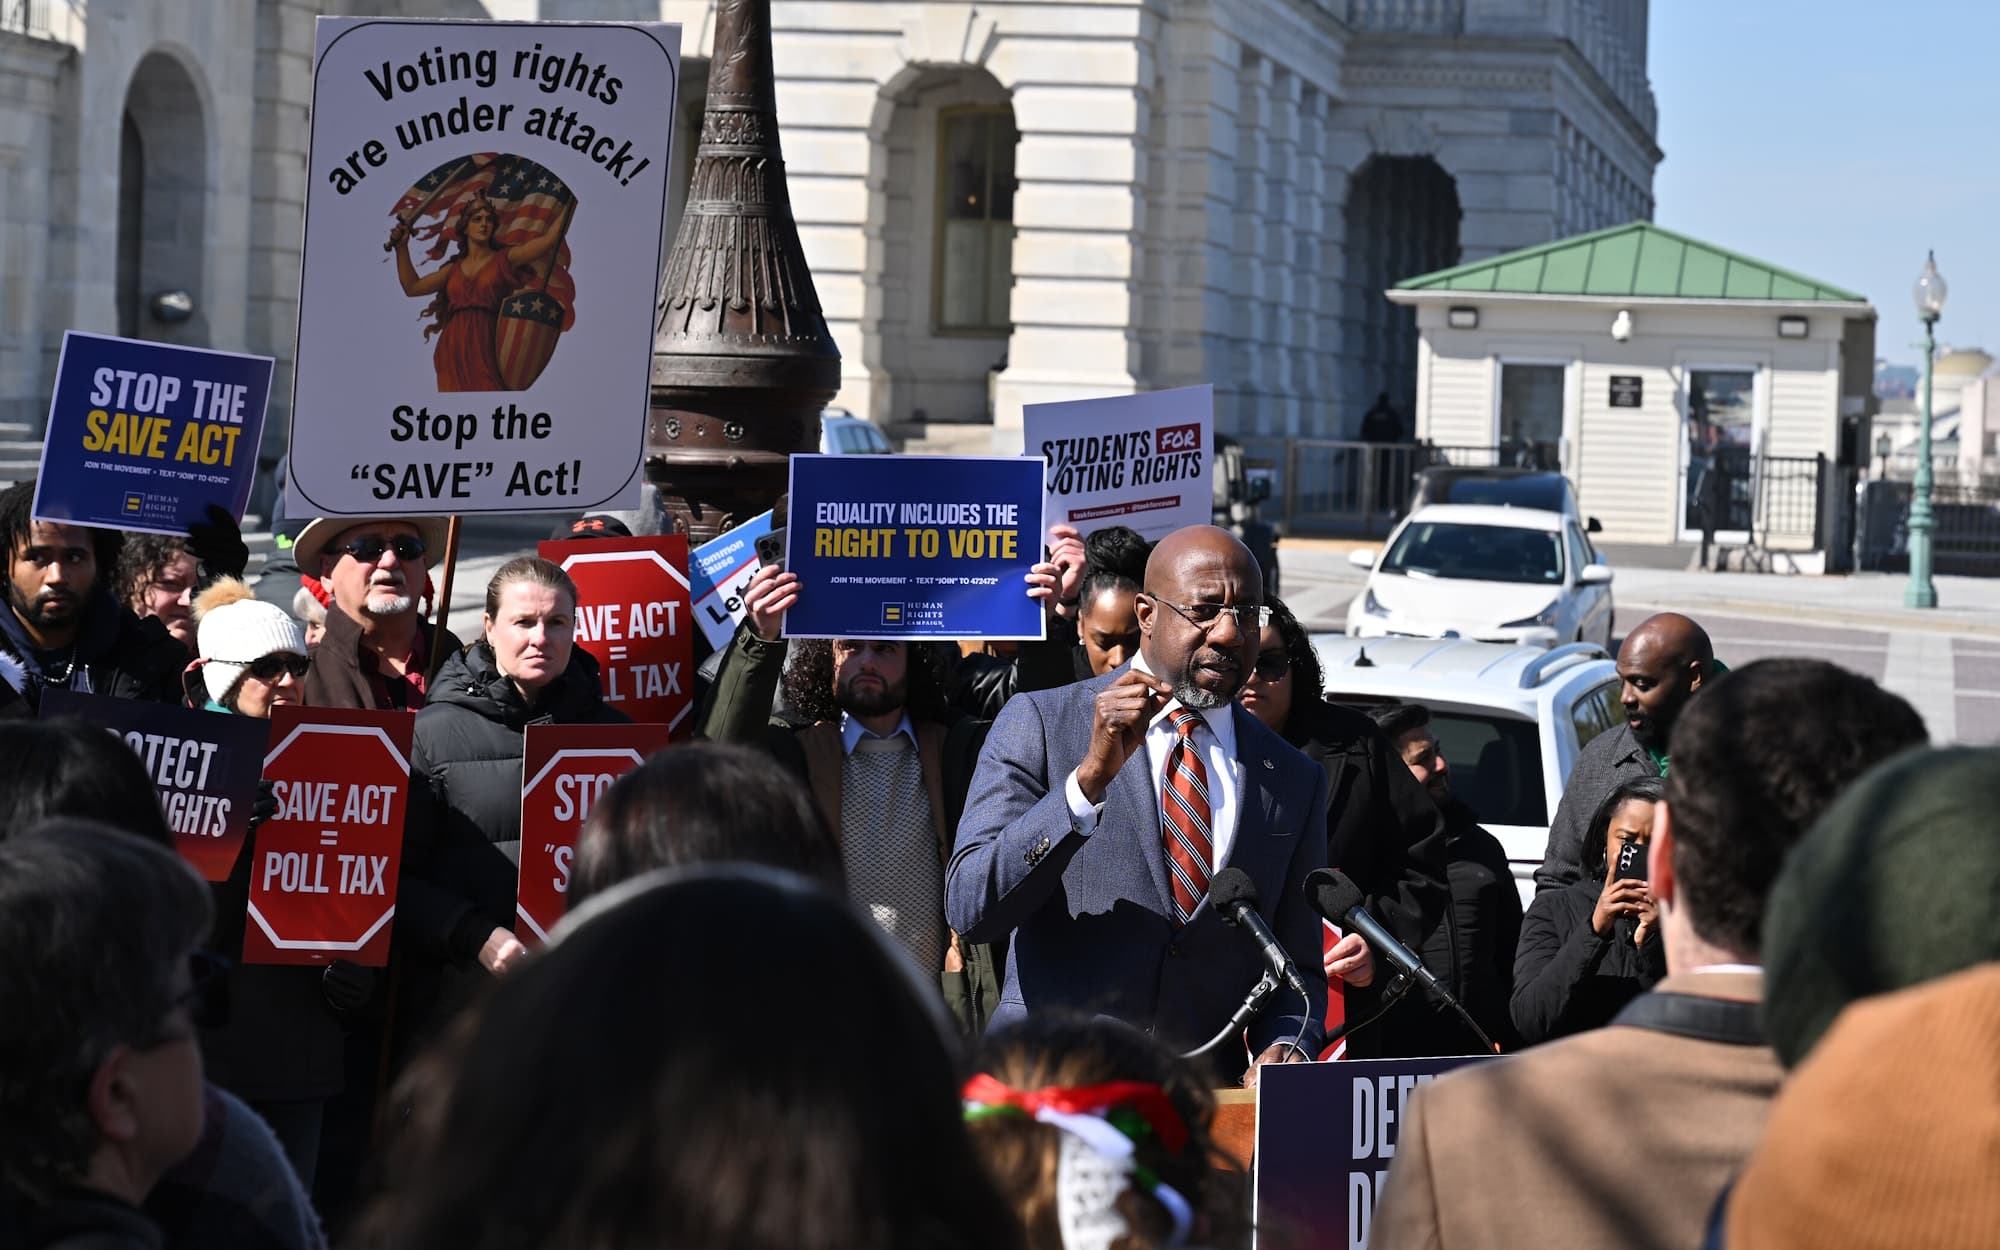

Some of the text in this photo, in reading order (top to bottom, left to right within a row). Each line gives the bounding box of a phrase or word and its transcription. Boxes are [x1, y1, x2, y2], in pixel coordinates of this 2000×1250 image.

[364, 43, 623, 105] Voting rights
[328, 96, 650, 195] are under attack!
[90, 367, 248, 424] STOP THE
[82, 409, 241, 467] SAVE ACT
[390, 404, 552, 450] Stop the
[1041, 429, 1196, 468] STUDENTS FOR
[84, 460, 100, 469] JOIN
[100, 462, 113, 471] THE
[114, 463, 152, 475] MOVEMENT
[159, 469, 176, 478] TEXT
[198, 474, 207, 482] TO
[505, 460, 581, 498] Act!
[1131, 450, 1202, 487] RIGHTS
[145, 503, 177, 513] RIGHTS
[147, 493, 179, 504] HUMAN
[815, 502, 1018, 526] EQUALITY INCLUDES THE
[695, 540, 745, 568] Common
[814, 528, 1018, 559] RIGHT TO VOTE
[700, 555, 735, 577] Cause
[830, 576, 848, 584] JOIN
[849, 576, 864, 584] THE
[865, 577, 907, 585] MOVEMENT
[916, 577, 934, 585] TEXT
[959, 577, 970, 585] TO
[572, 600, 680, 641] AVE ACT
[630, 661, 681, 699] TAX
[155, 790, 232, 838] IGHTS
[271, 780, 397, 825] SAVE ACT
[262, 851, 389, 896] POLL TAX
